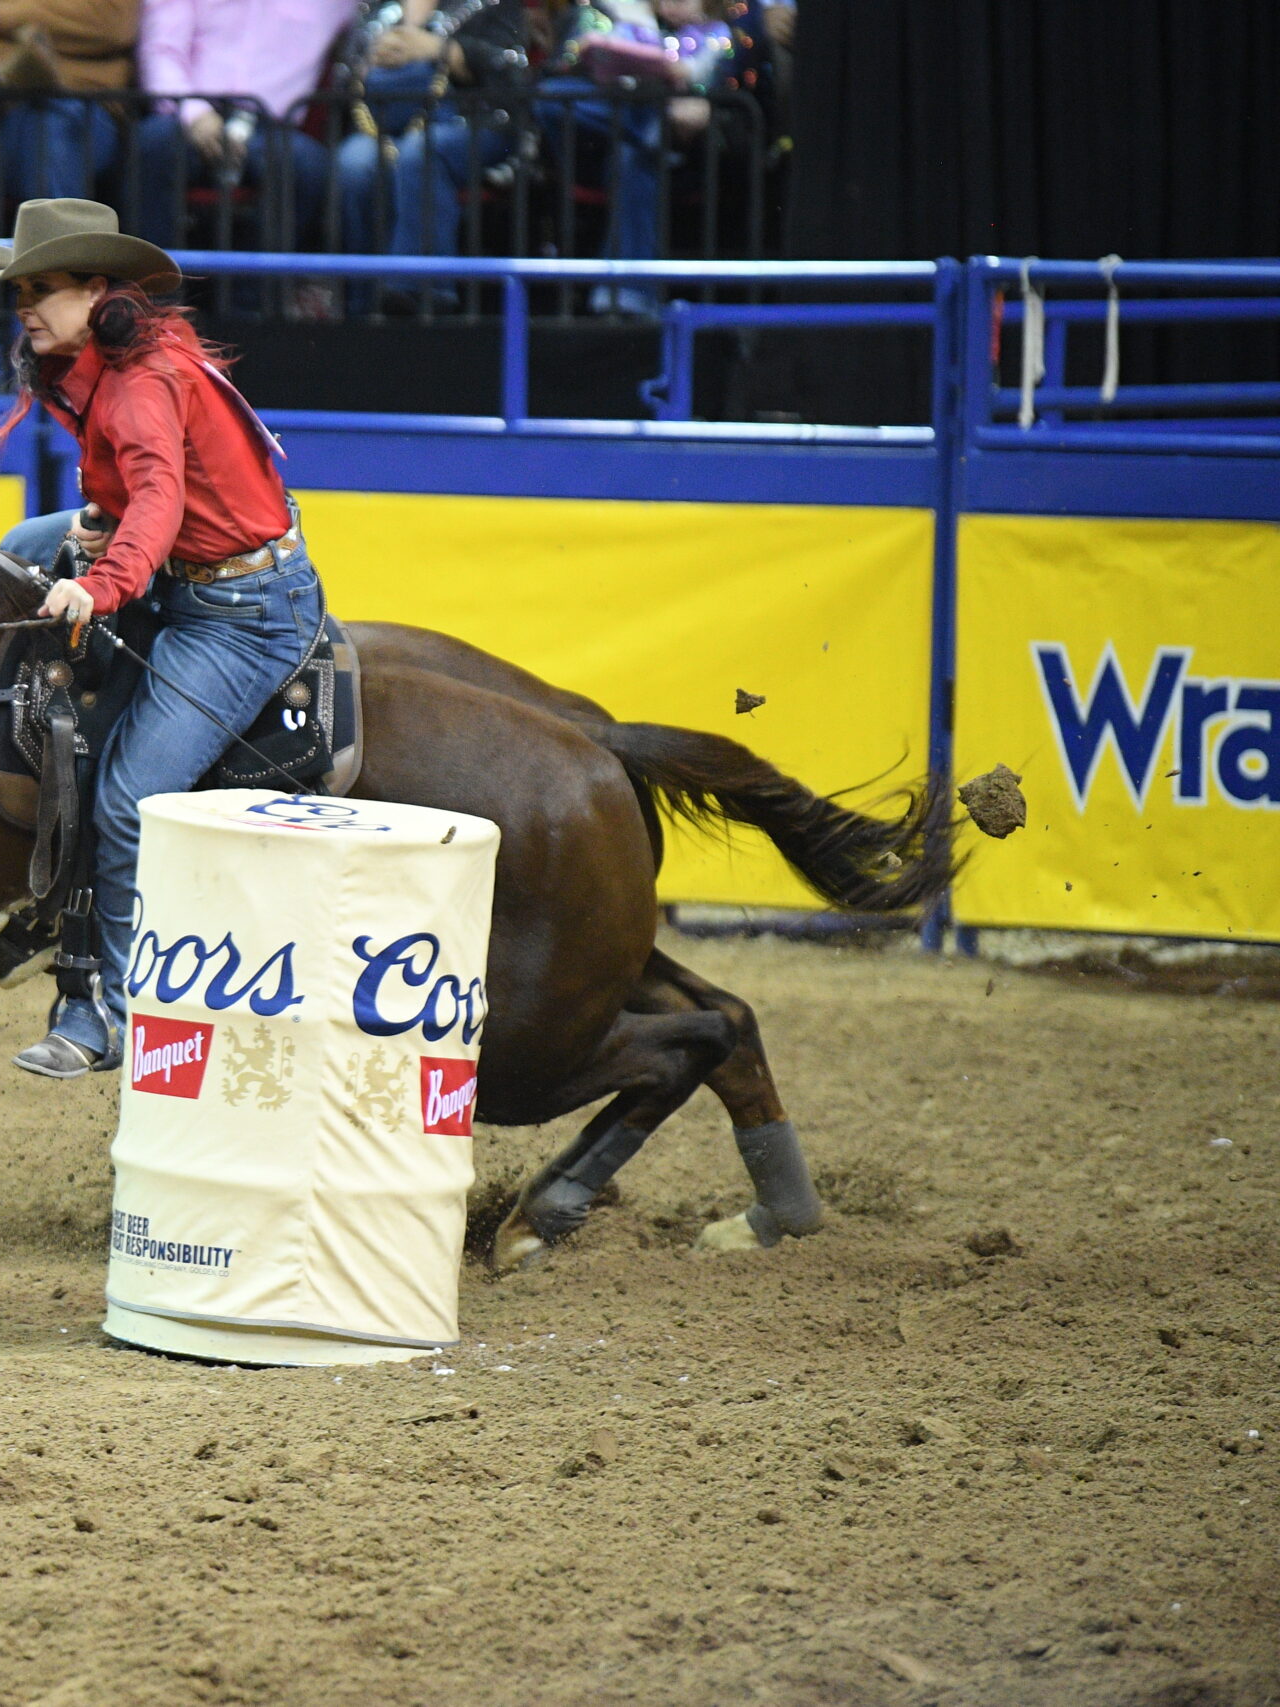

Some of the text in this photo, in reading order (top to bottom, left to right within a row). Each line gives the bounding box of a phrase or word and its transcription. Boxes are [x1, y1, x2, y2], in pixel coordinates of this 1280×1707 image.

[1031, 641, 1280, 813] Wra
[123, 889, 305, 1017] oors
[132, 1025, 205, 1083] Banquet
[126, 1235, 233, 1268] RESPONSIBILITY
[128, 1213, 149, 1237] BEER
